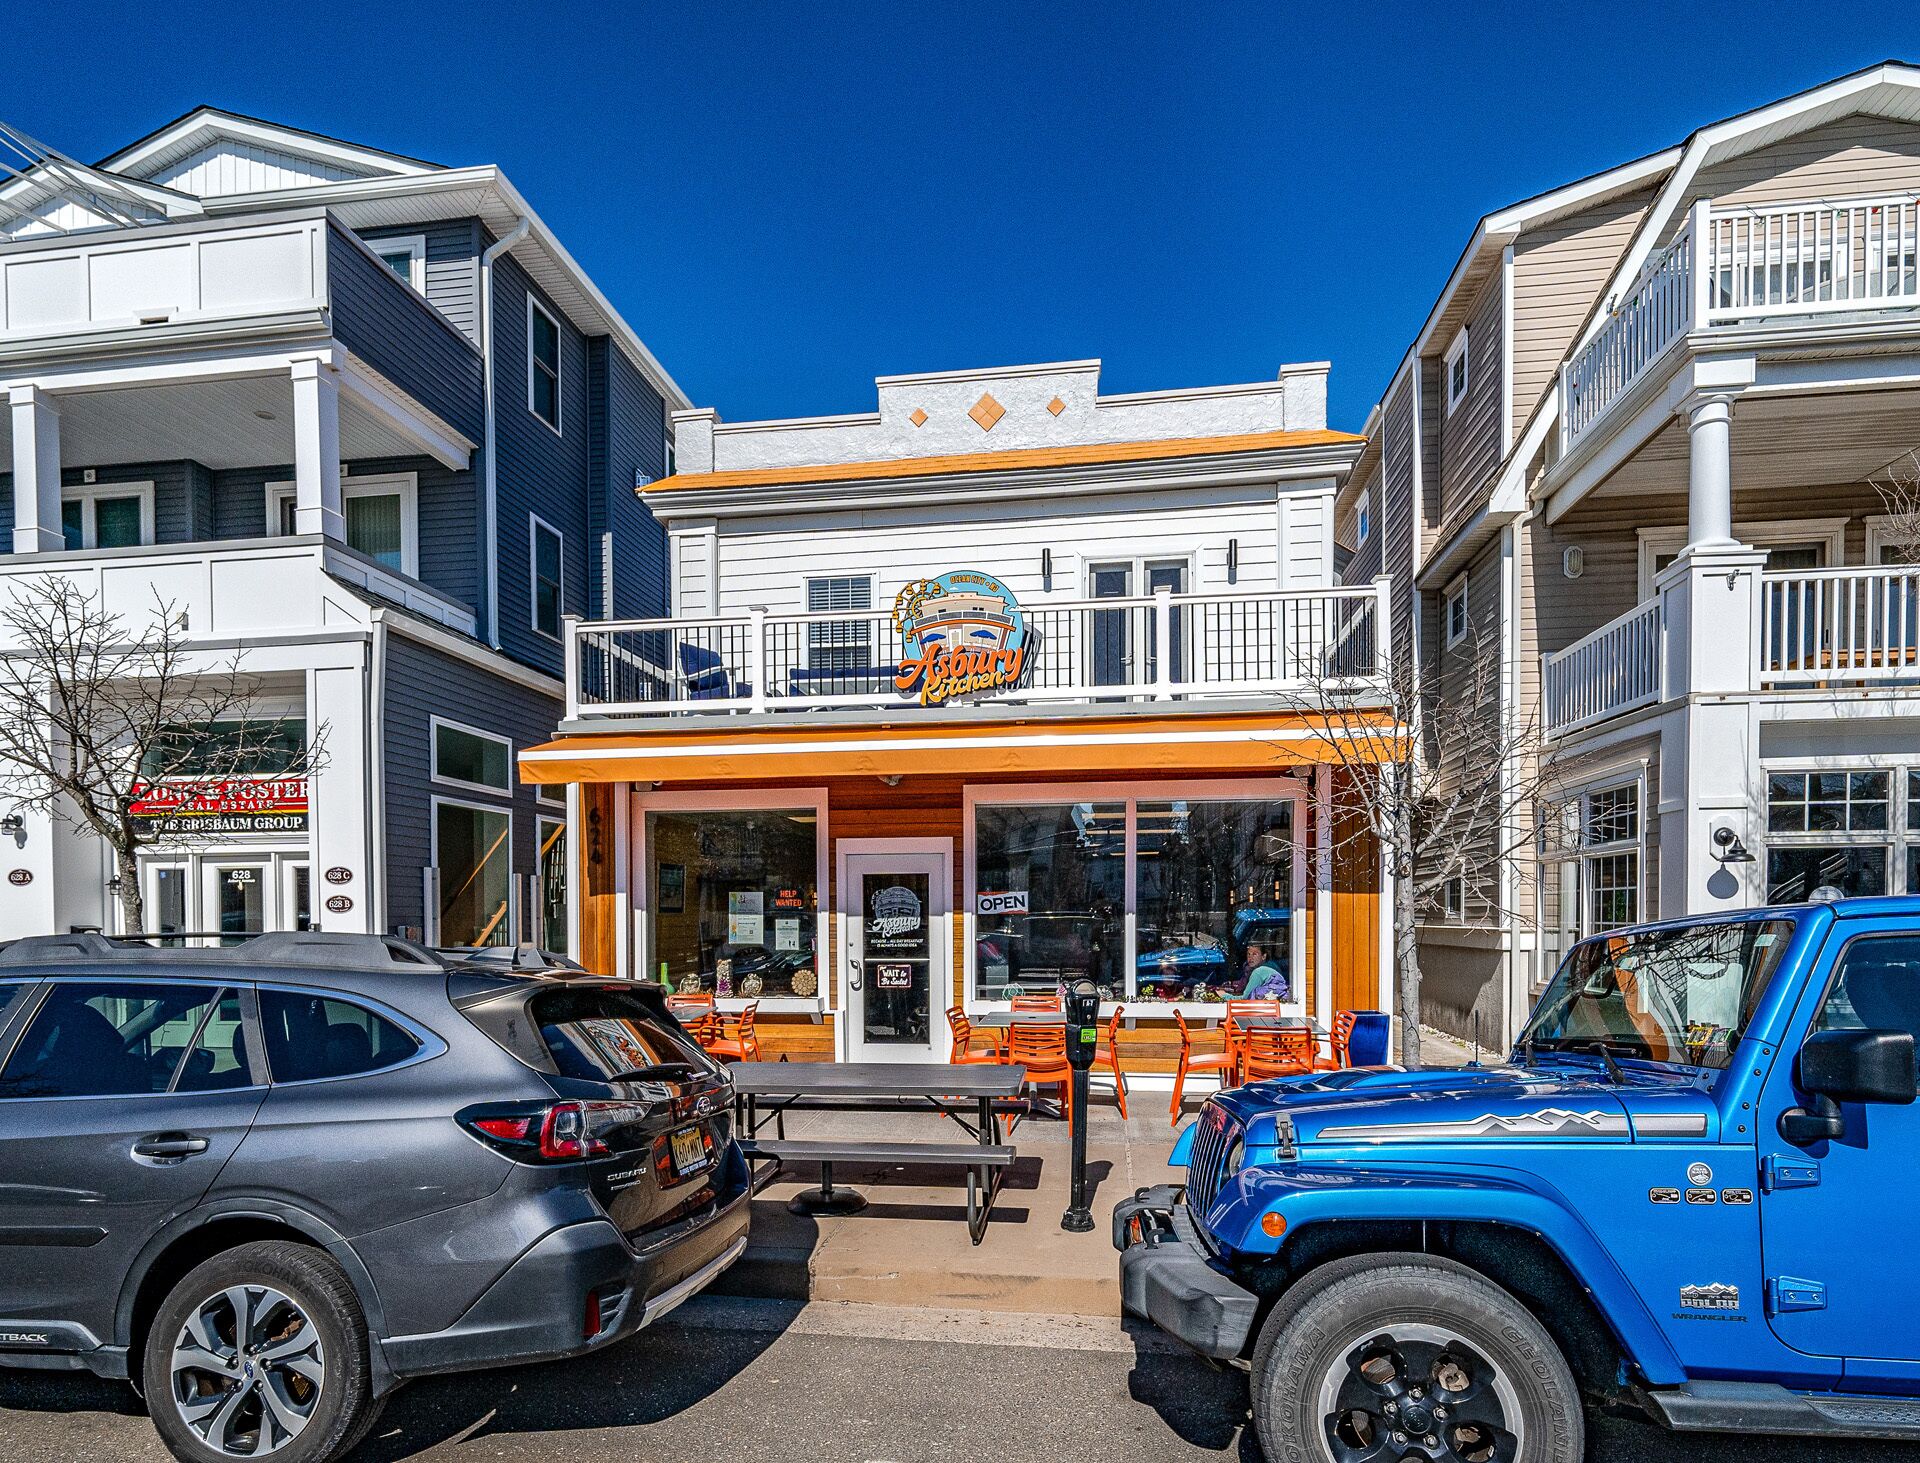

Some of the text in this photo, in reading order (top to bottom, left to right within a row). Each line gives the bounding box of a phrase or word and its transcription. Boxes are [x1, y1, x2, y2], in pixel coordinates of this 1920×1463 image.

[950, 574, 999, 592] OCEAN CITY NJ
[895, 643, 1023, 689] Asbury
[920, 671, 1005, 706] Kitchen
[221, 800, 274, 810] ESTATE
[254, 816, 303, 830] GROUP
[232, 870, 251, 879] 628
[328, 871, 350, 880] 628 C
[780, 890, 797, 898] HELP
[329, 900, 351, 908] 628 B
[775, 899, 802, 907] WANTED
[981, 895, 1025, 911] OPEN
[872, 916, 921, 932] Asbury
[882, 924, 911, 938] Kitchen
[882, 969, 900, 977] WAIT
[880, 977, 890, 985] Be
[607, 1167, 647, 1181] SUBARU
[1672, 1313, 1748, 1323] WRANGLER
[0, 1333, 48, 1342] TBACK
